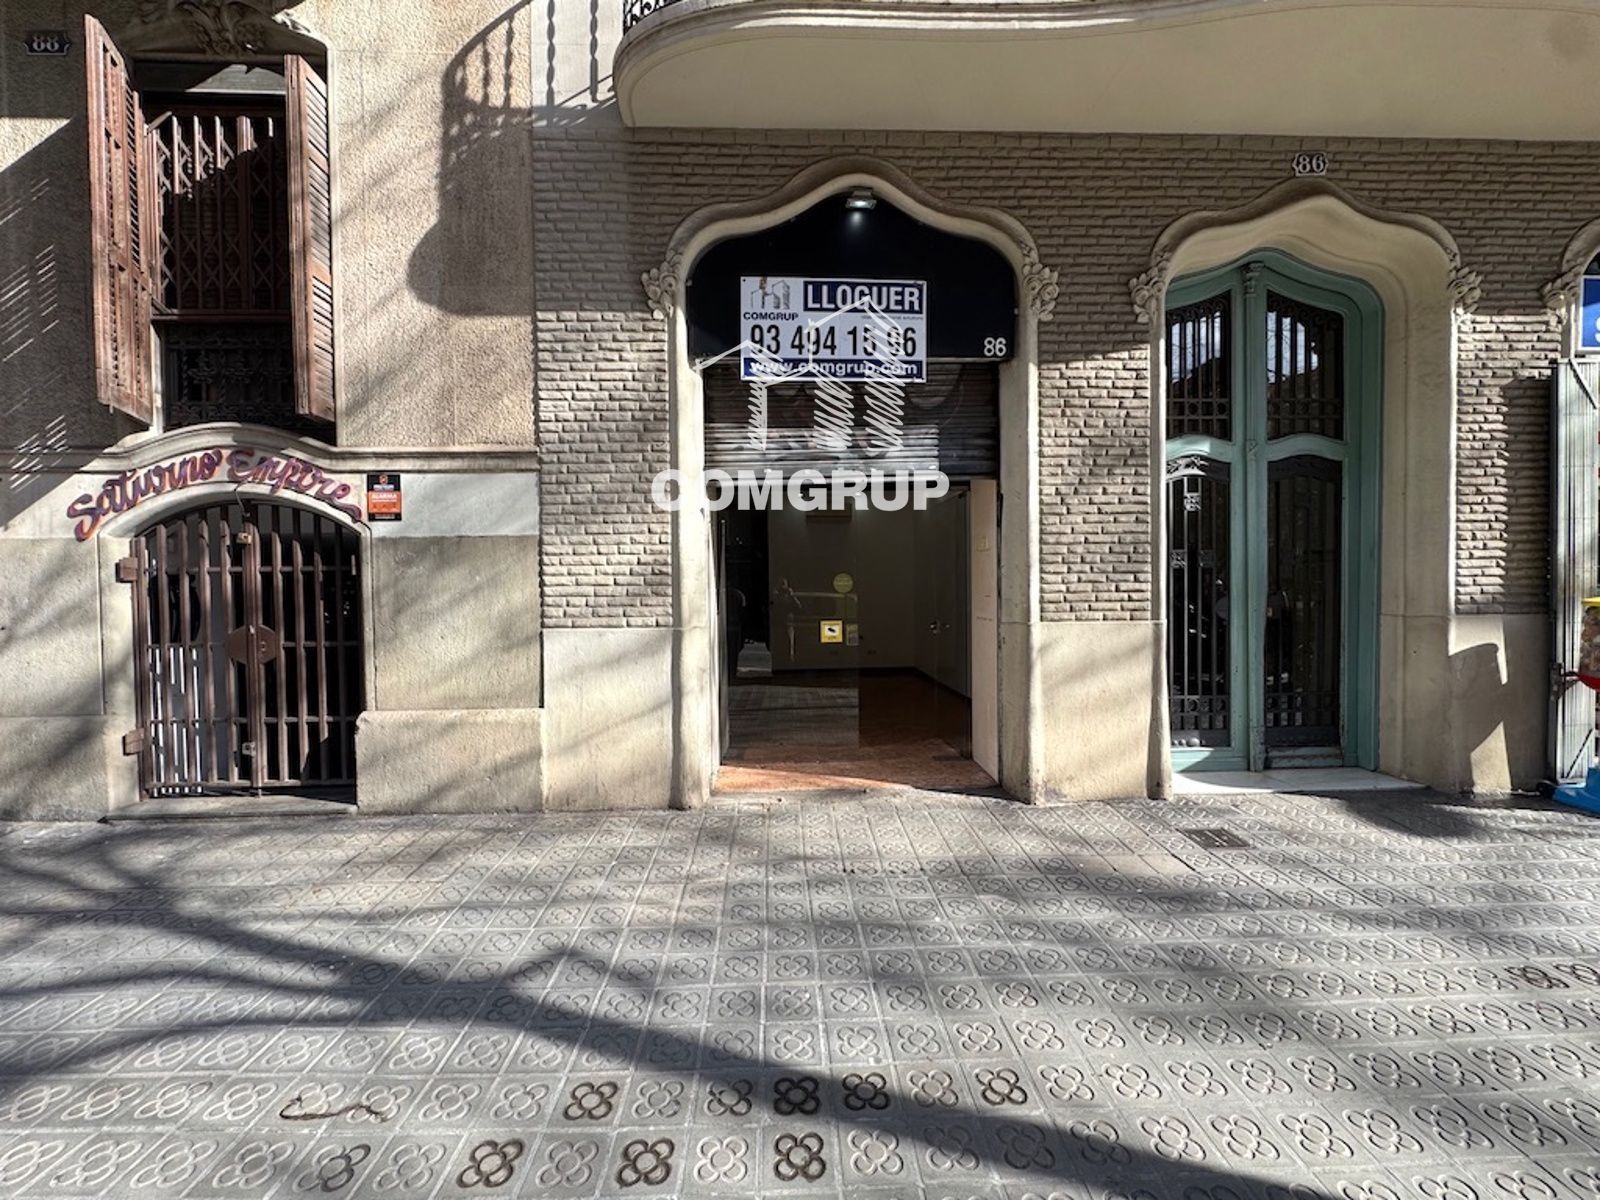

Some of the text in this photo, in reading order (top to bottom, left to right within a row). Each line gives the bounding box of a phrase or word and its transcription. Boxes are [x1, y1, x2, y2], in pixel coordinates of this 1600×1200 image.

[33, 33, 60, 51] 88
[1298, 154, 1324, 172] 86
[807, 284, 920, 311] LLOGUER
[743, 311, 799, 321] COMGRUP
[750, 324, 781, 356] 93
[790, 325, 837, 356] 494
[847, 326, 876, 356] 15
[984, 337, 1007, 357] 86
[66, 448, 223, 543] Saturno
